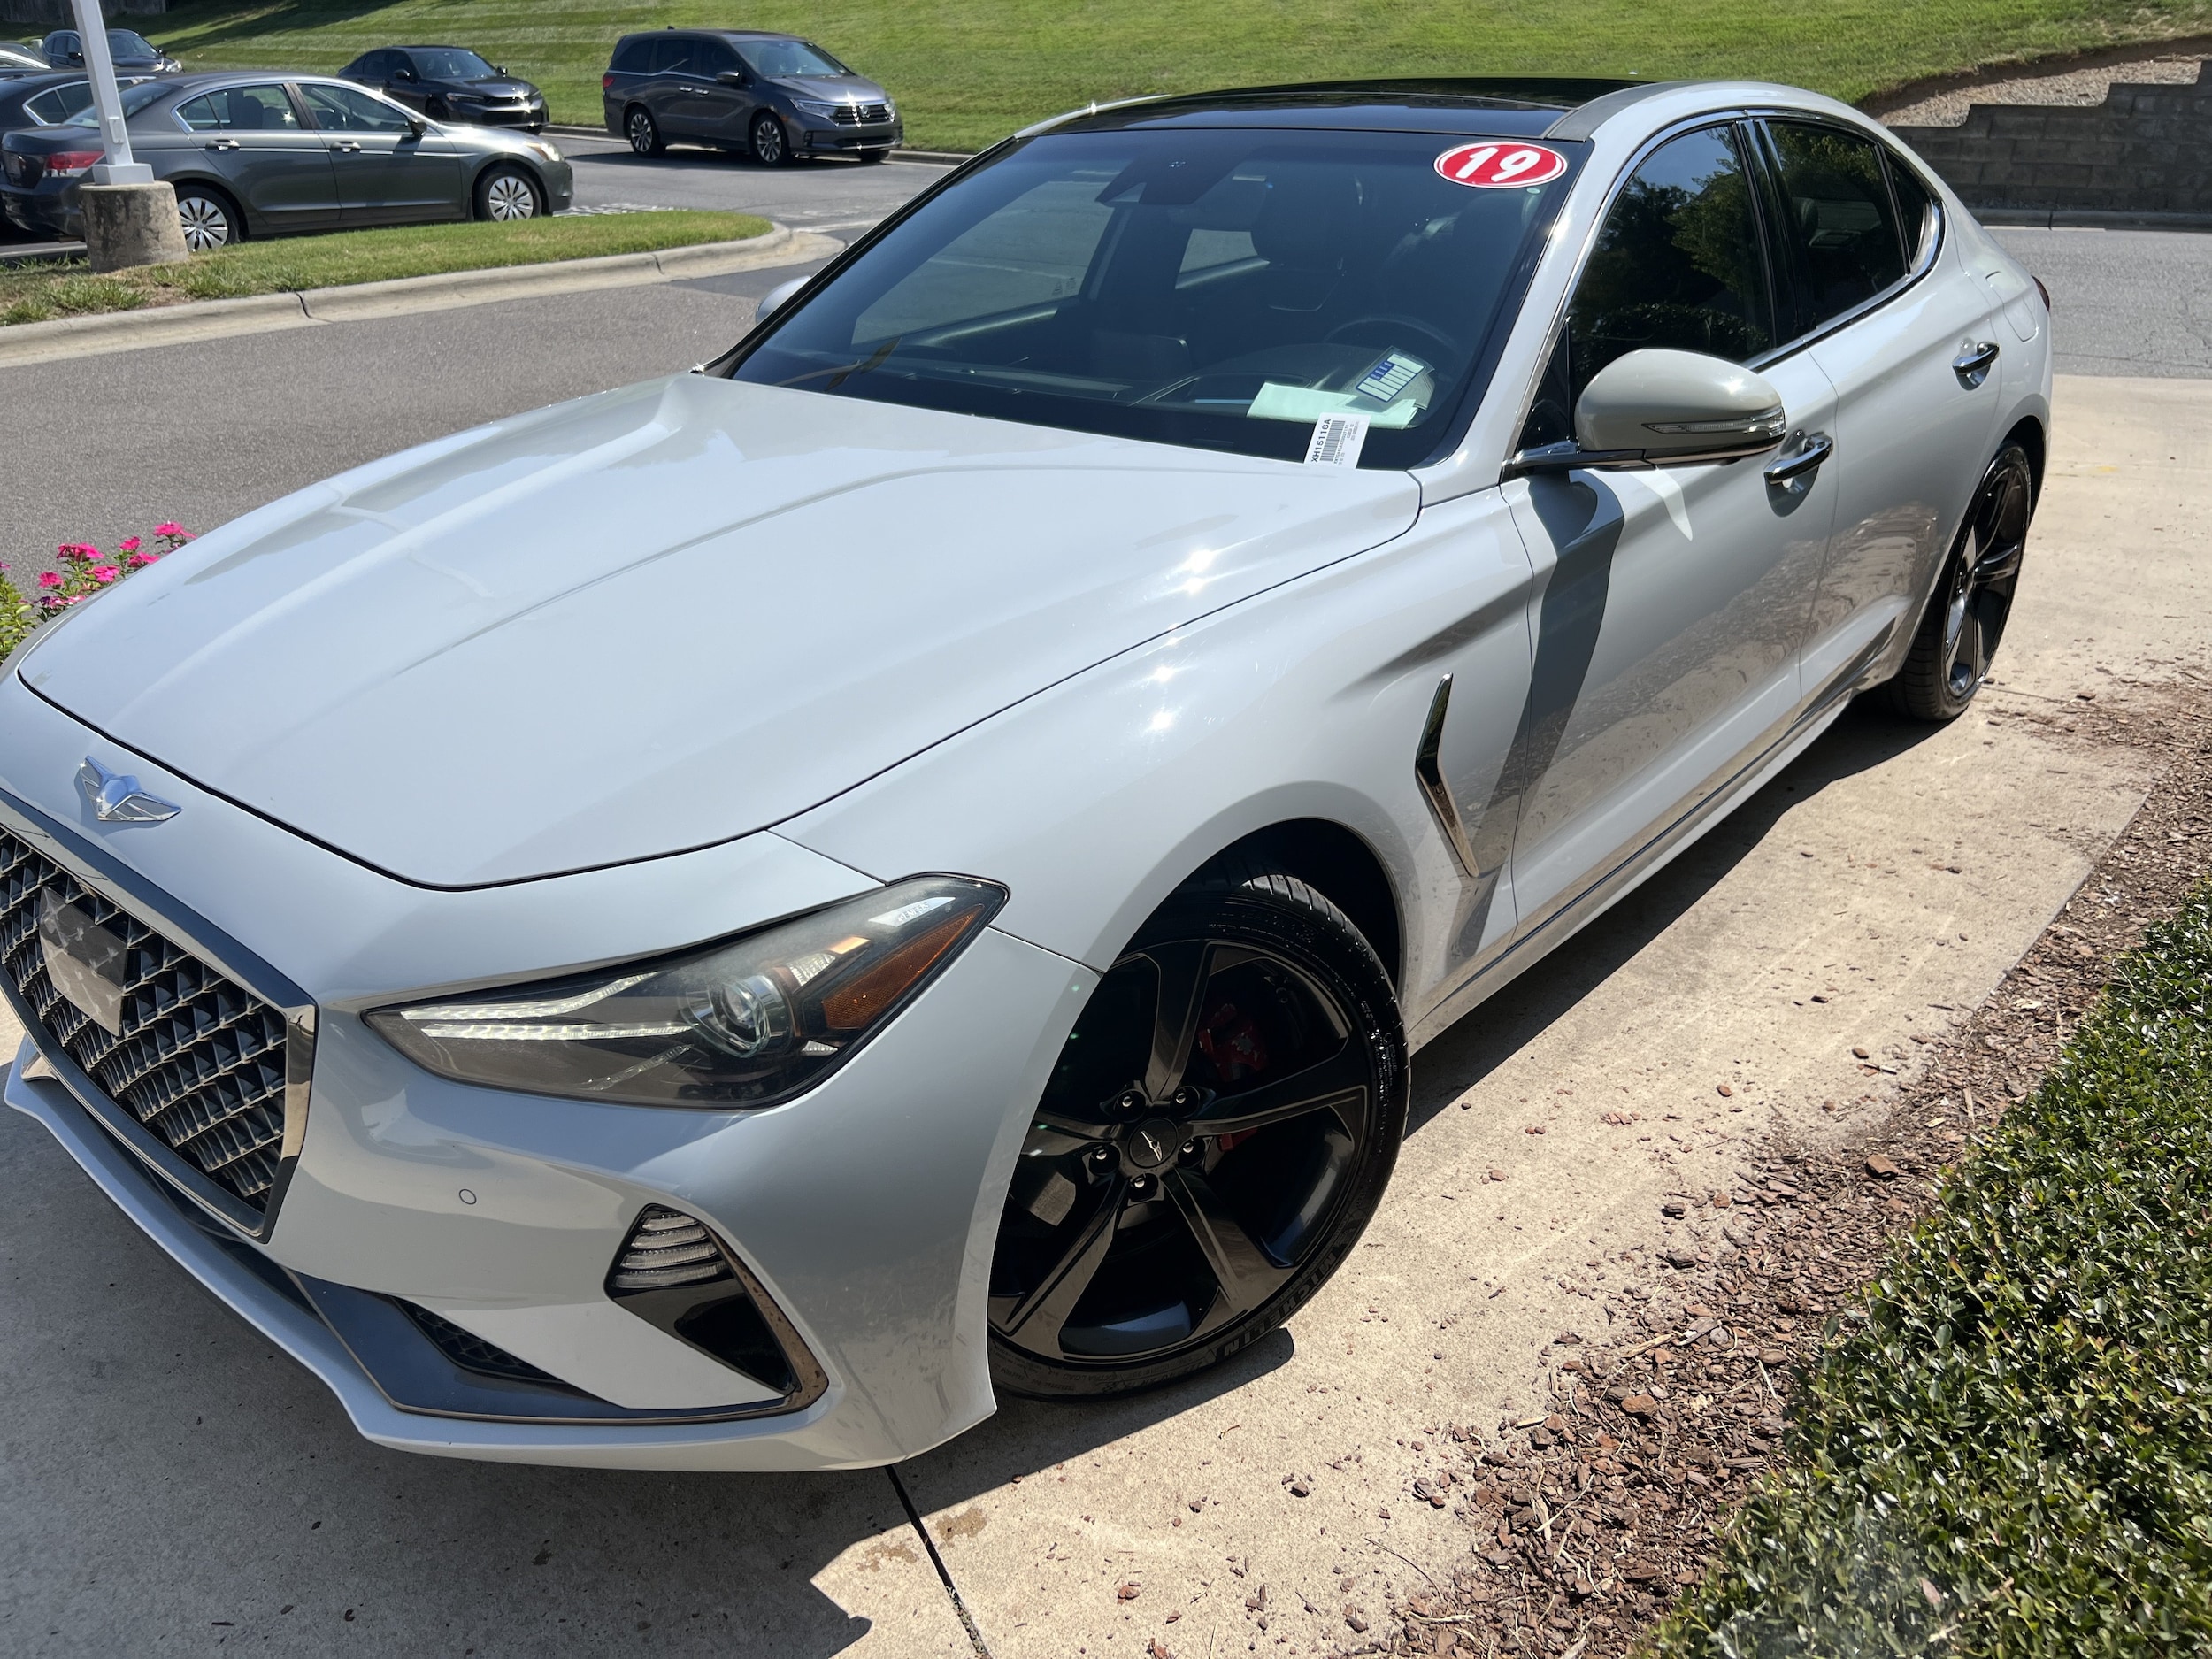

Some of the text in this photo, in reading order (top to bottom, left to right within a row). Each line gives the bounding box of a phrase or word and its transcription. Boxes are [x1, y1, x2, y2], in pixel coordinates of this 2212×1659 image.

[1455, 146, 1541, 182] 19
[1310, 419, 1332, 463] XH15116A
[897, 902, 929, 922] GENESIS
[1224, 1252, 1338, 1356] MICHELIN
